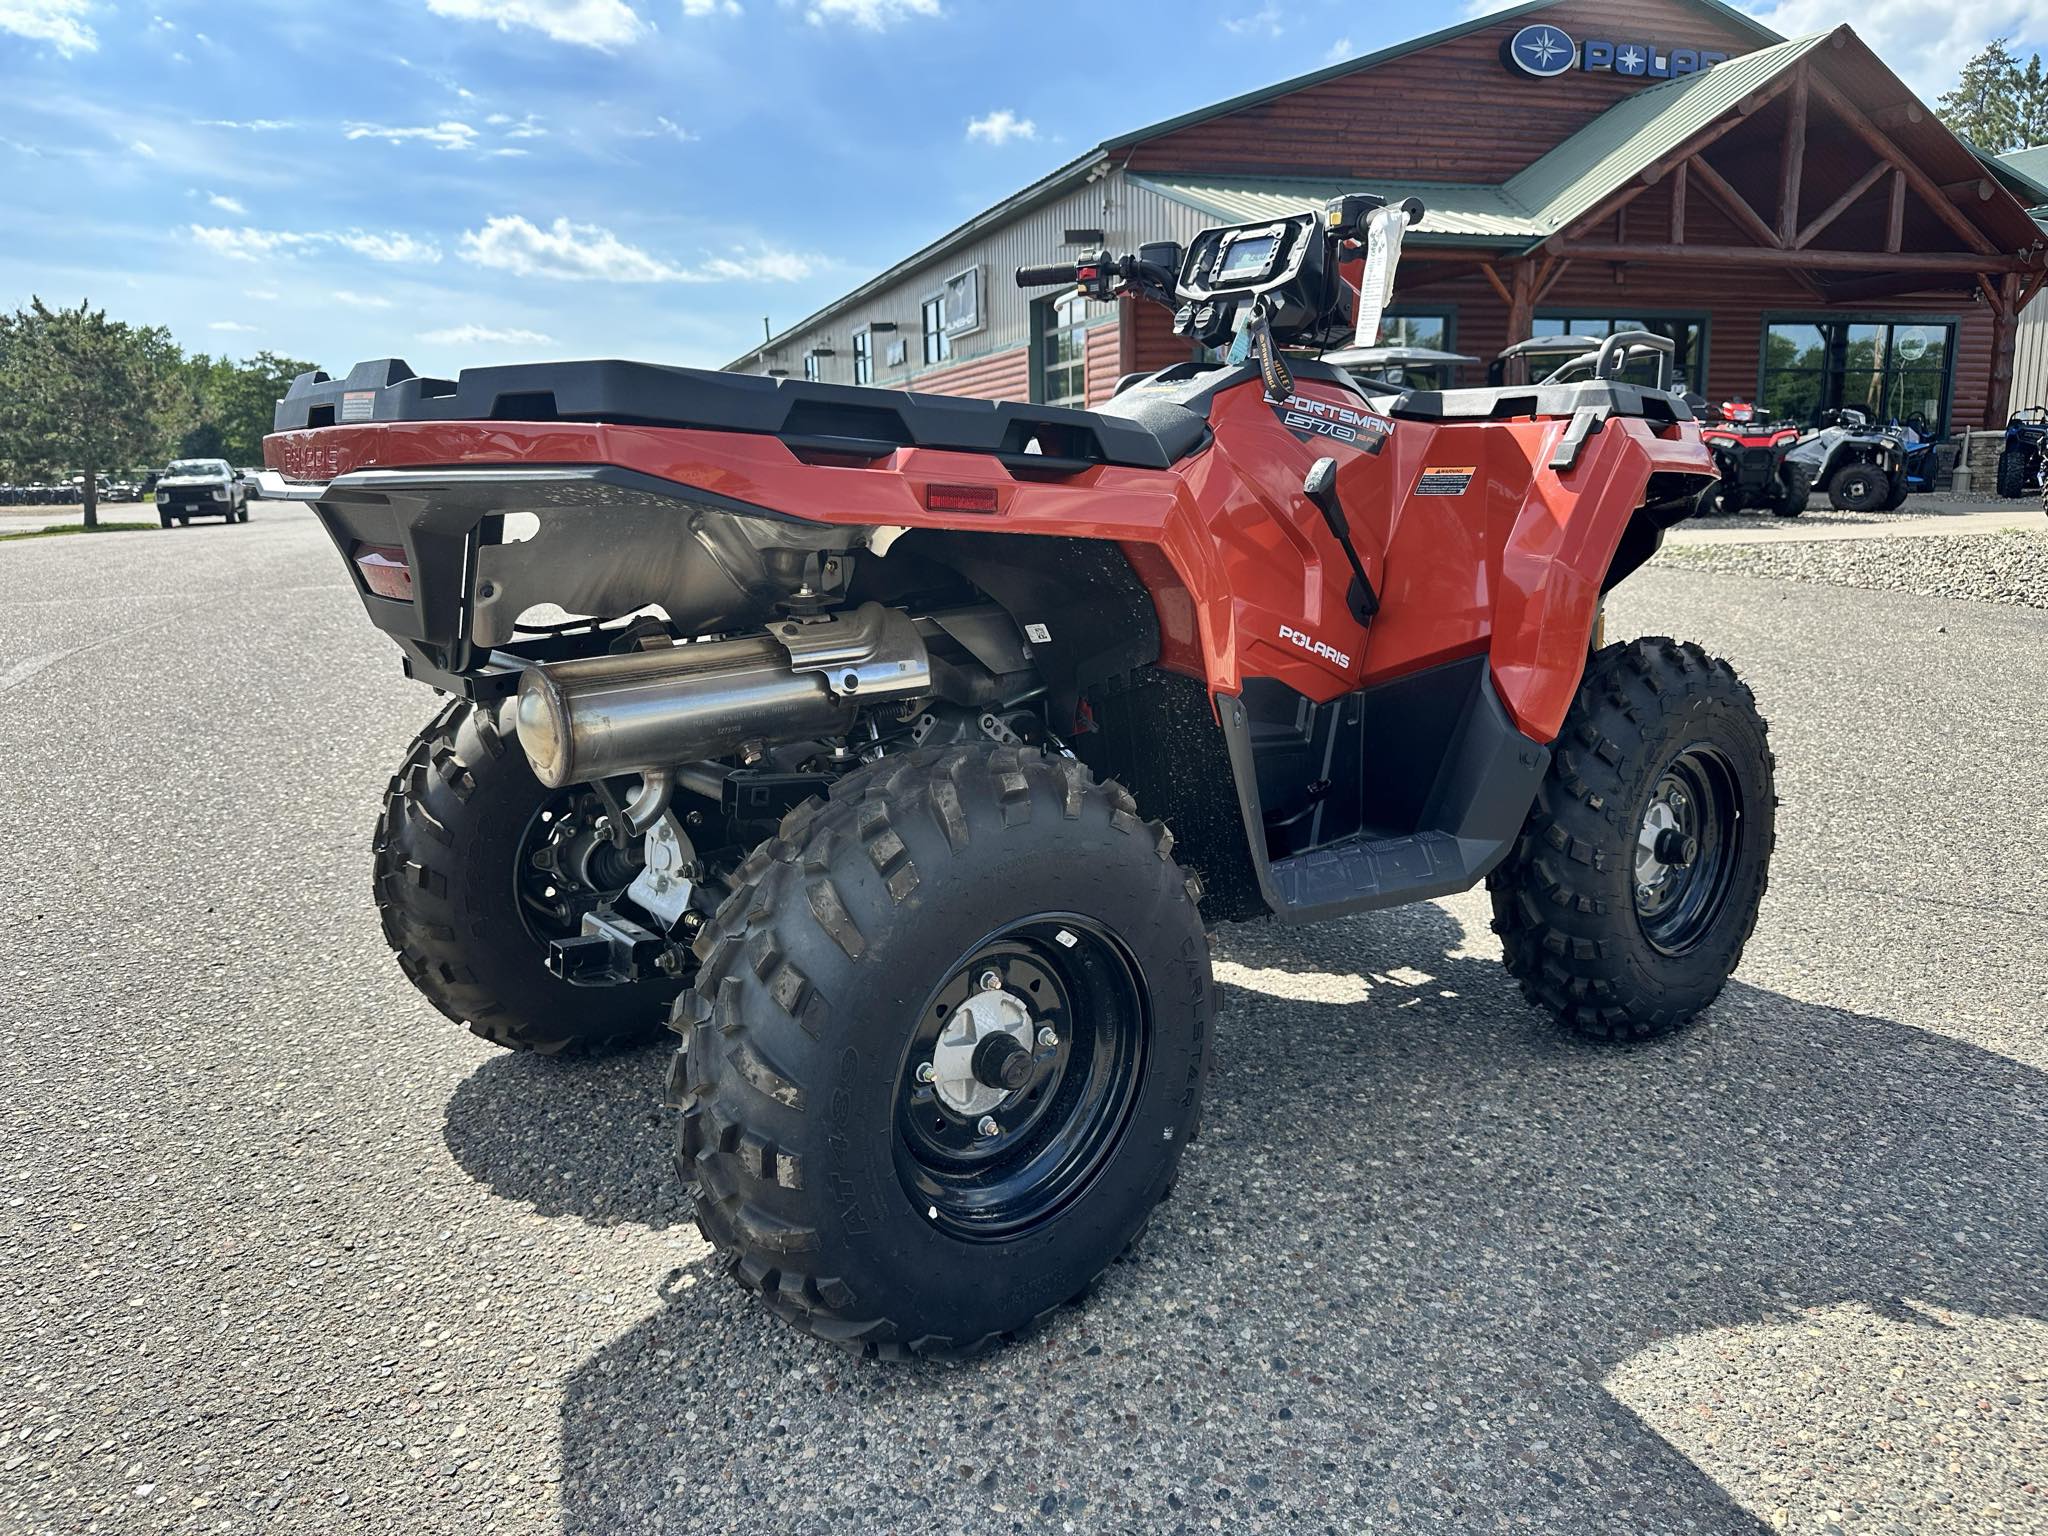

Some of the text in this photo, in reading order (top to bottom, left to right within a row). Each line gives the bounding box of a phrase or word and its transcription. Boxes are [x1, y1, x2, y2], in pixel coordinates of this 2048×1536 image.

[1583, 41, 1728, 78] POLA
[1284, 411, 1356, 442] 570
[1279, 625, 1350, 669] POLARIS
